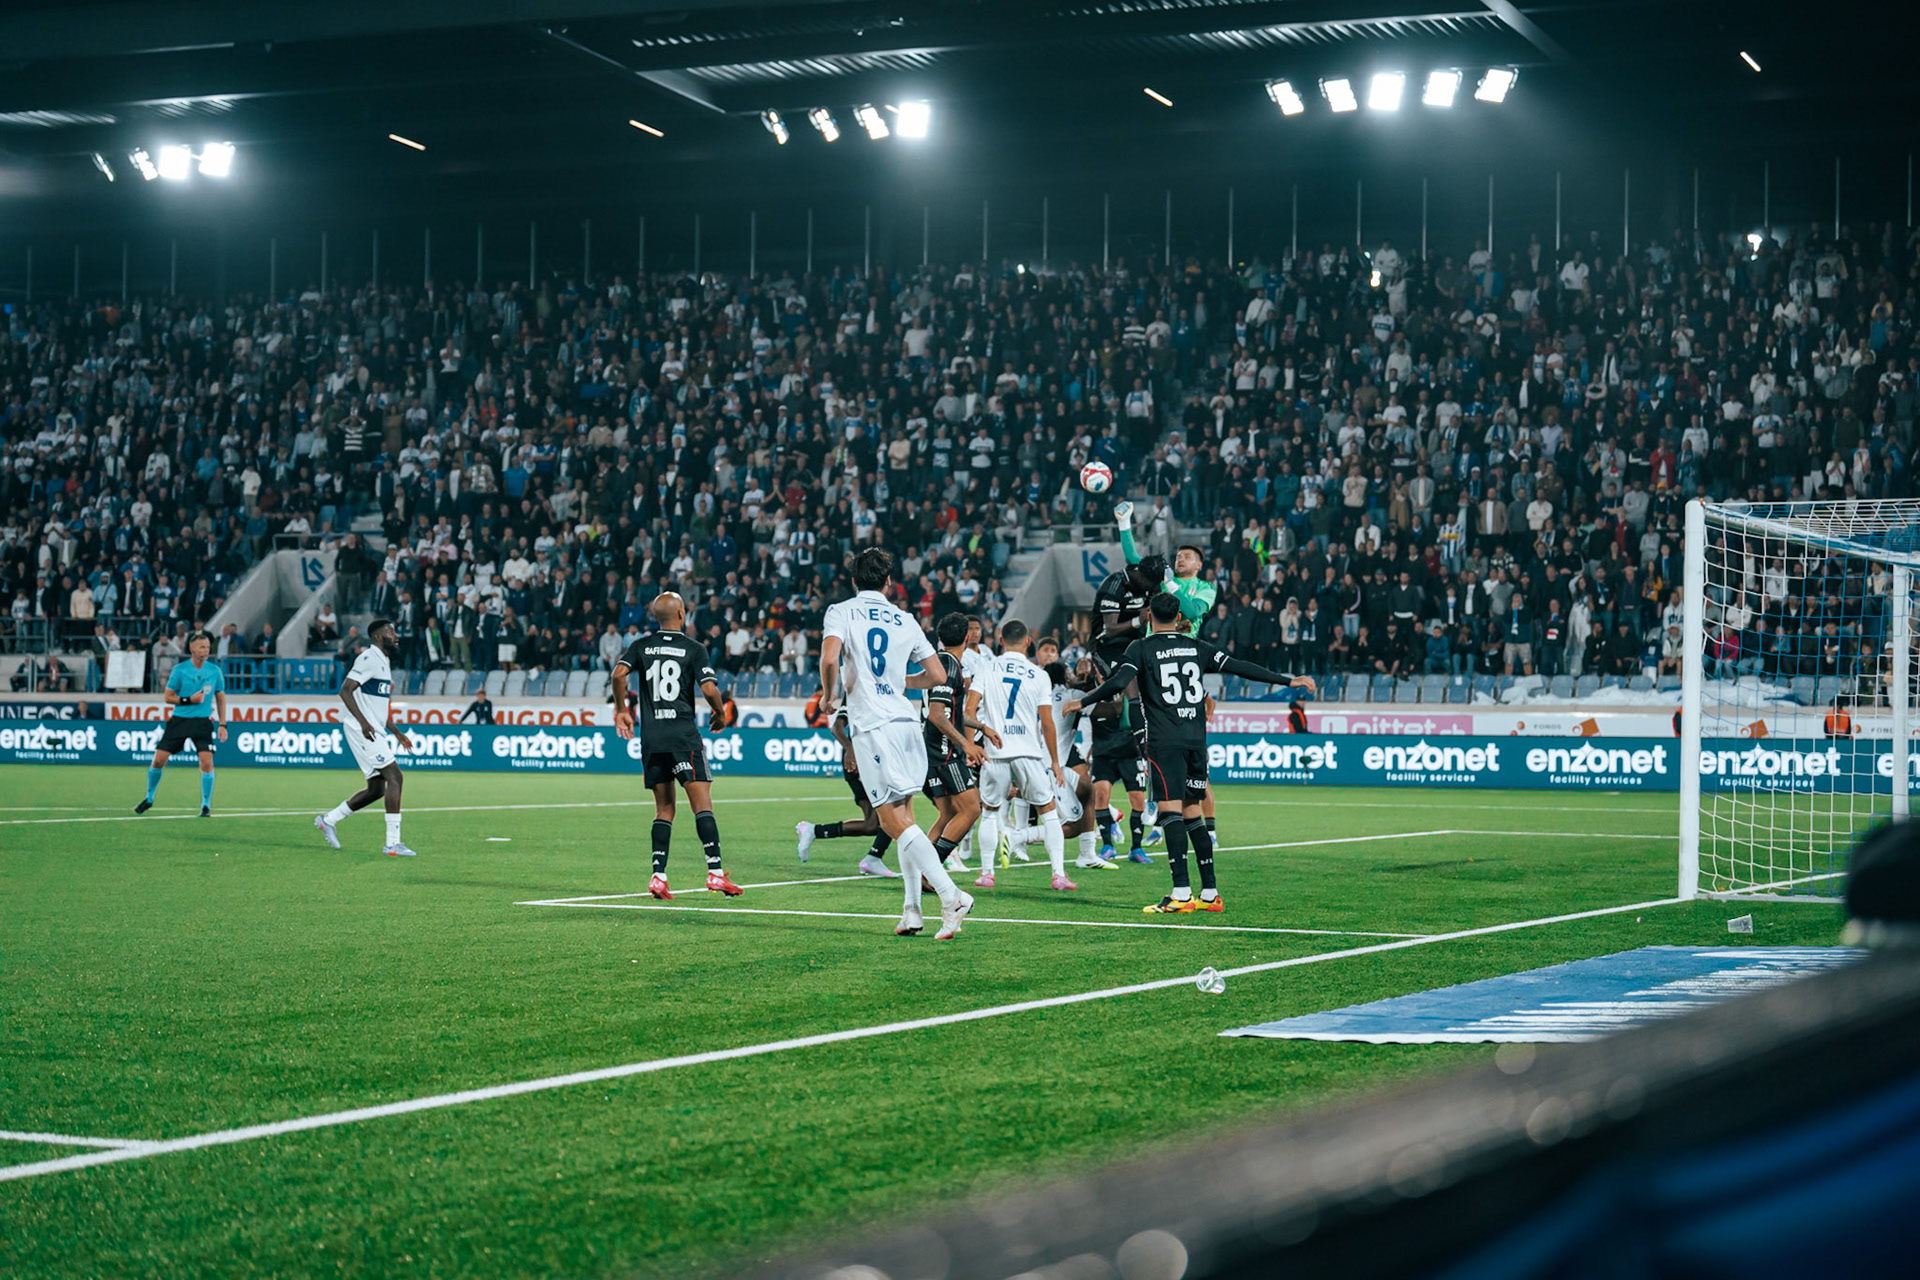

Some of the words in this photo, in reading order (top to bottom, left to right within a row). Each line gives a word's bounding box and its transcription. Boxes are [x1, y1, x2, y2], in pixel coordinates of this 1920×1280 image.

[851, 608, 902, 627] INEOS
[867, 627, 889, 677] 8
[646, 660, 681, 701] 18
[993, 662, 1035, 679] INEOS
[1160, 662, 1203, 704] 53
[1003, 677, 1021, 719] 7
[232, 707, 341, 723] MIGROS
[390, 709, 462, 724] GROS
[0, 726, 97, 751] enzonet
[237, 729, 343, 754] enzonet
[385, 731, 472, 757] nzonet
[492, 731, 606, 759] enzonet
[764, 736, 842, 762] enzo
[1206, 741, 1338, 769] enzonet
[1363, 743, 1500, 772] enzonet
[1526, 745, 1667, 774] enzonet
[1700, 747, 1841, 777] enzonet
[1228, 770, 1267, 781] facility
[1386, 772, 1426, 783] facility
[1430, 774, 1476, 782] services
[1550, 774, 1591, 786] facility
[1595, 776, 1643, 785] services
